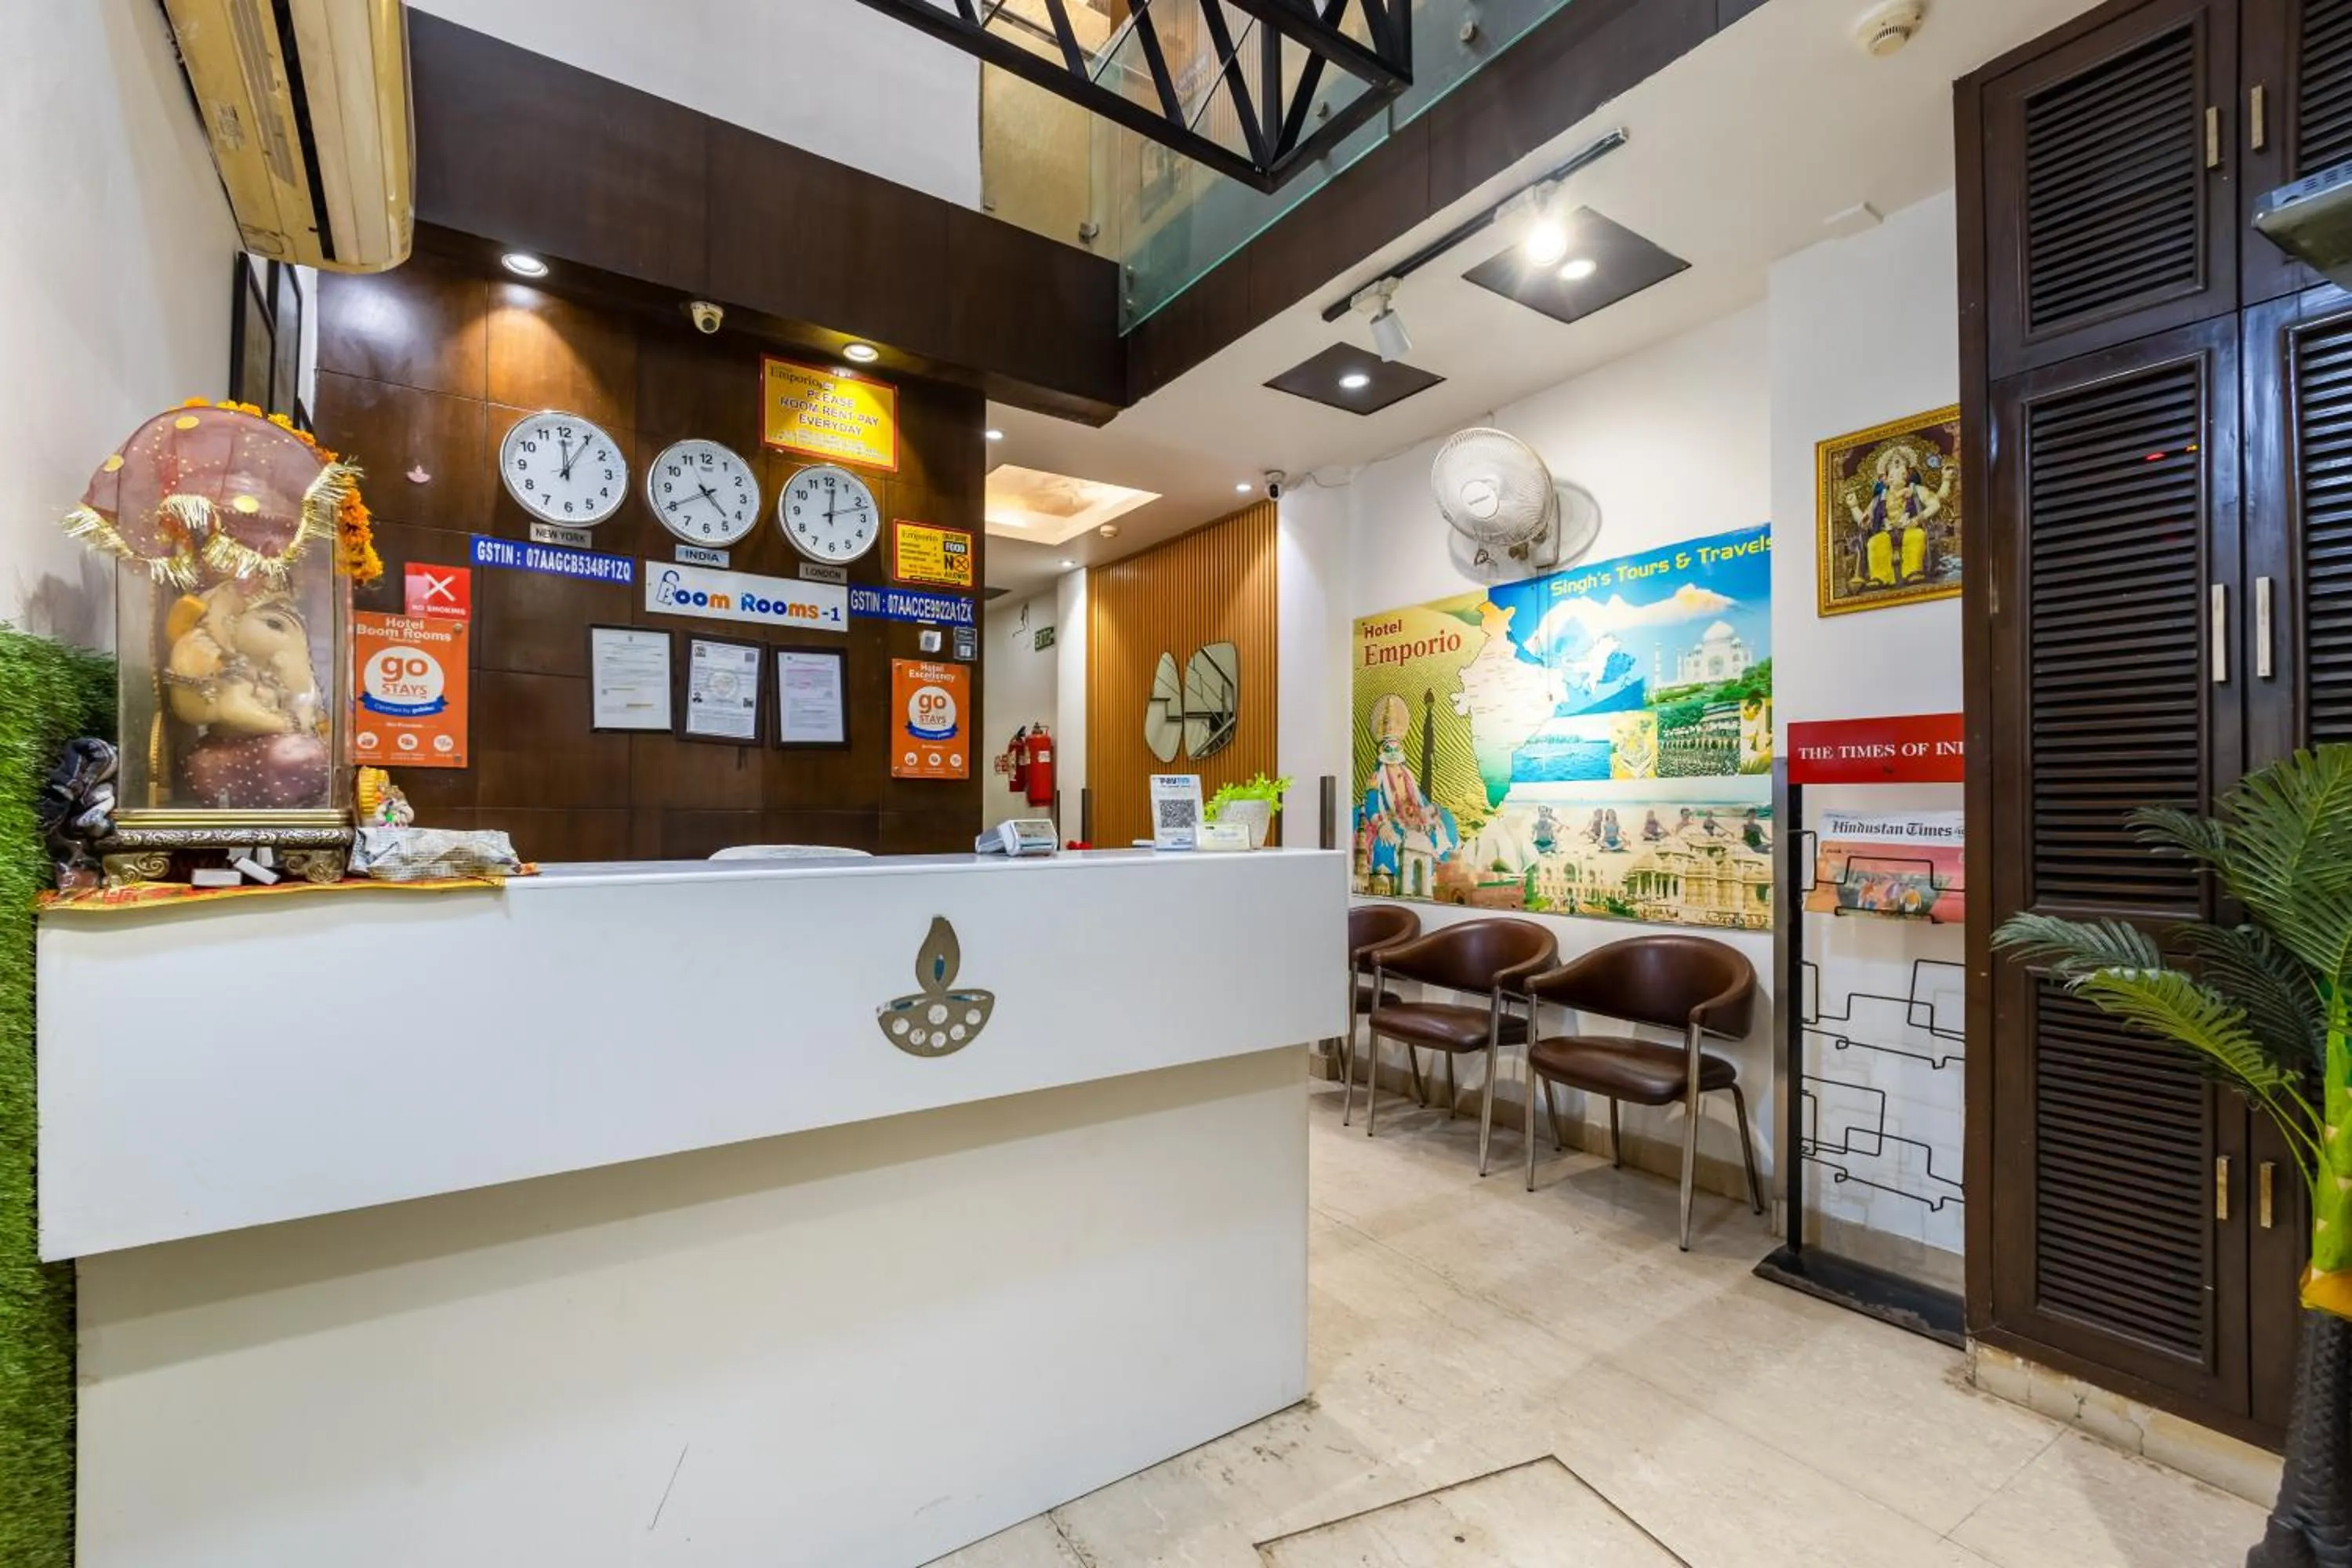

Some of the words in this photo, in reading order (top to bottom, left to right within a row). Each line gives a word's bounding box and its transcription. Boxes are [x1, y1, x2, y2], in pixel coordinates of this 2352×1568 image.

[807, 390, 855, 408] PLEASE
[780, 395, 818, 414] ROOM
[823, 405, 854, 421] RENT
[800, 413, 862, 435] EVERYDAY
[537, 430, 549, 439] 11
[557, 426, 572, 437] 12
[521, 441, 535, 452] 10
[597, 451, 606, 461] 2
[682, 456, 693, 466] 11
[700, 453, 712, 464] 12
[517, 459, 527, 470] 9
[723, 462, 728, 472] 1
[604, 470, 612, 480] 3
[668, 466, 681, 477] 10
[525, 479, 534, 489] 8
[664, 482, 672, 492] 9
[735, 477, 742, 487] 2
[808, 479, 818, 489] 11
[823, 477, 835, 487] 12
[601, 488, 608, 498] 4
[796, 490, 808, 500] 10
[844, 485, 849, 494] 1
[542, 494, 550, 505] 7
[586, 499, 594, 510] 5
[739, 494, 747, 504] 3
[855, 497, 862, 506] 2
[564, 502, 573, 513] 6
[670, 501, 677, 511] 8
[793, 506, 800, 515] 9
[684, 516, 691, 526] 7
[735, 511, 742, 521] 4
[860, 514, 866, 523] 3
[702, 523, 710, 533] 6
[721, 521, 729, 532] 5
[799, 523, 806, 532] 8
[535, 528, 557, 539] NEW
[561, 531, 586, 543] YORK
[855, 529, 862, 538] 4
[811, 535, 818, 546] 7
[844, 539, 851, 550] 5
[829, 543, 836, 552] 6
[945, 542, 965, 553] FOOD
[684, 550, 720, 562] INDIA
[526, 547, 631, 582] 07AAGCB5348F1ZQ
[805, 567, 841, 579] LONDON
[1551, 571, 1611, 597] Singh's
[1616, 557, 1670, 583] Tours
[1675, 552, 1692, 569] &
[427, 605, 466, 615] SMOKING
[386, 617, 424, 630] Hotel
[1364, 619, 1402, 639] Hotel
[357, 623, 398, 637] Boom
[404, 628, 452, 641] Rooms
[1364, 630, 1461, 666] Emporio
[380, 655, 429, 683] go
[382, 683, 427, 696] STAYS
[918, 694, 946, 713] go
[919, 714, 946, 725] STAYS
[1798, 746, 1833, 760] THE
[1838, 744, 1895, 759] TIMES
[1901, 742, 1929, 757] OF
[1832, 820, 1904, 835] Hindustan
[1907, 822, 1952, 837] Times
